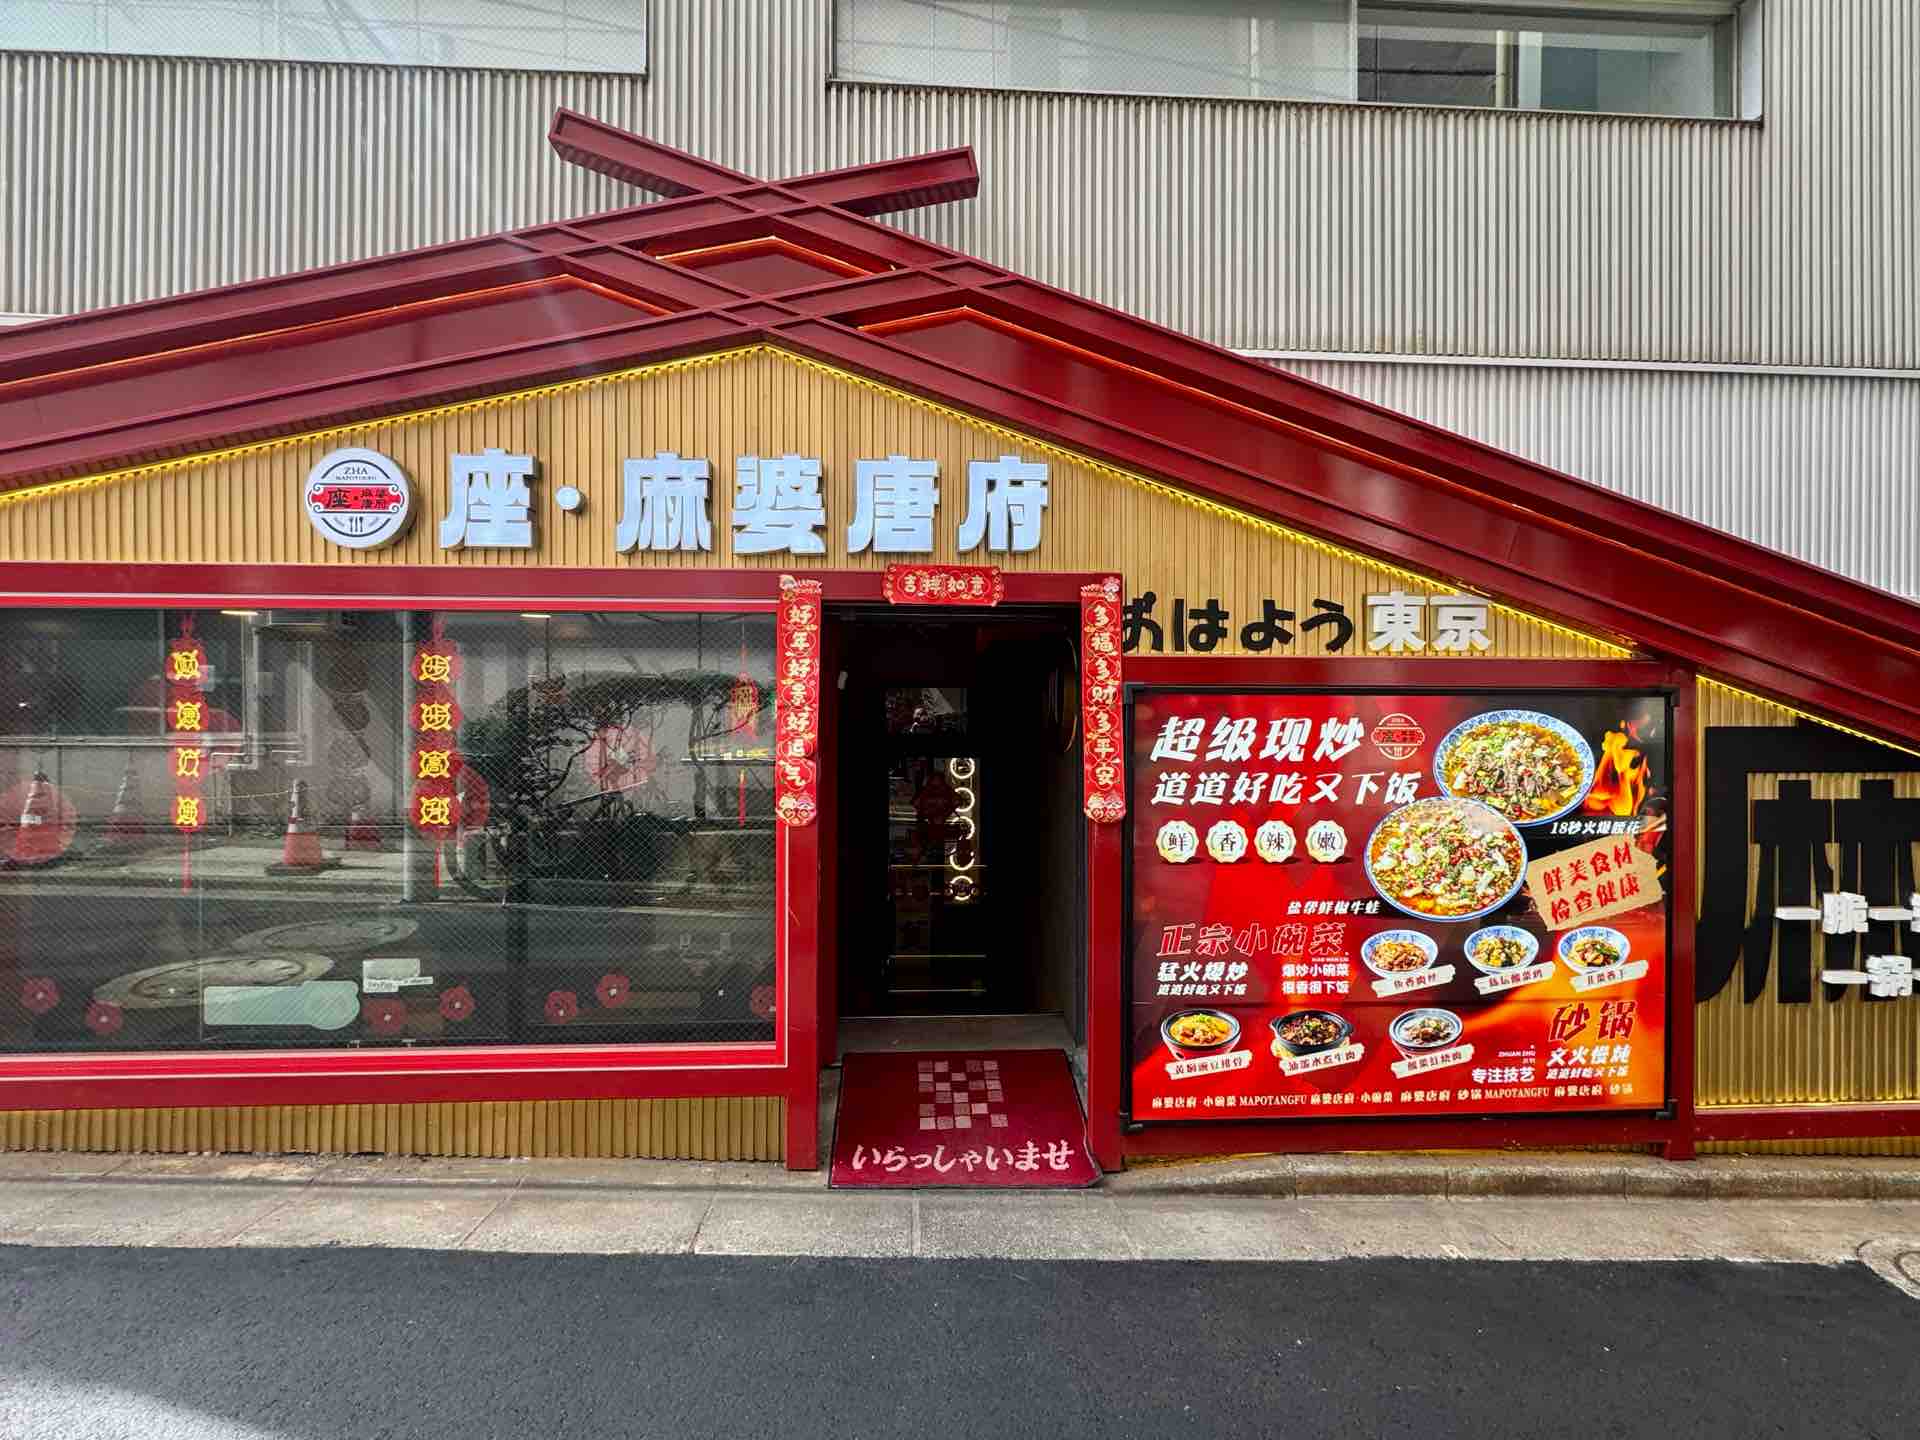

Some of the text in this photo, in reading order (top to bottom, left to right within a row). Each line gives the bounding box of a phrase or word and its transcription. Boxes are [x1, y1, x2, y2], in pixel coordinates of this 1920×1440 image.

[343, 466, 368, 475] ZHA
[903, 574, 987, 595] 吉祥如意
[1149, 715, 1365, 762] 超级现炒
[1150, 771, 1422, 806] 道道好吃又下饭
[1543, 841, 1634, 896] 鲜美食材
[1156, 922, 1346, 957] 正宗小碗菜
[1157, 961, 1249, 982] 猛火爆炒
[1156, 983, 1248, 996] 道道好吃又下饭
[1548, 1000, 1637, 1042] 砂锅
[1472, 1067, 1536, 1083] 专注技艺
[851, 1139, 1075, 1174] いらっしゃいませ
